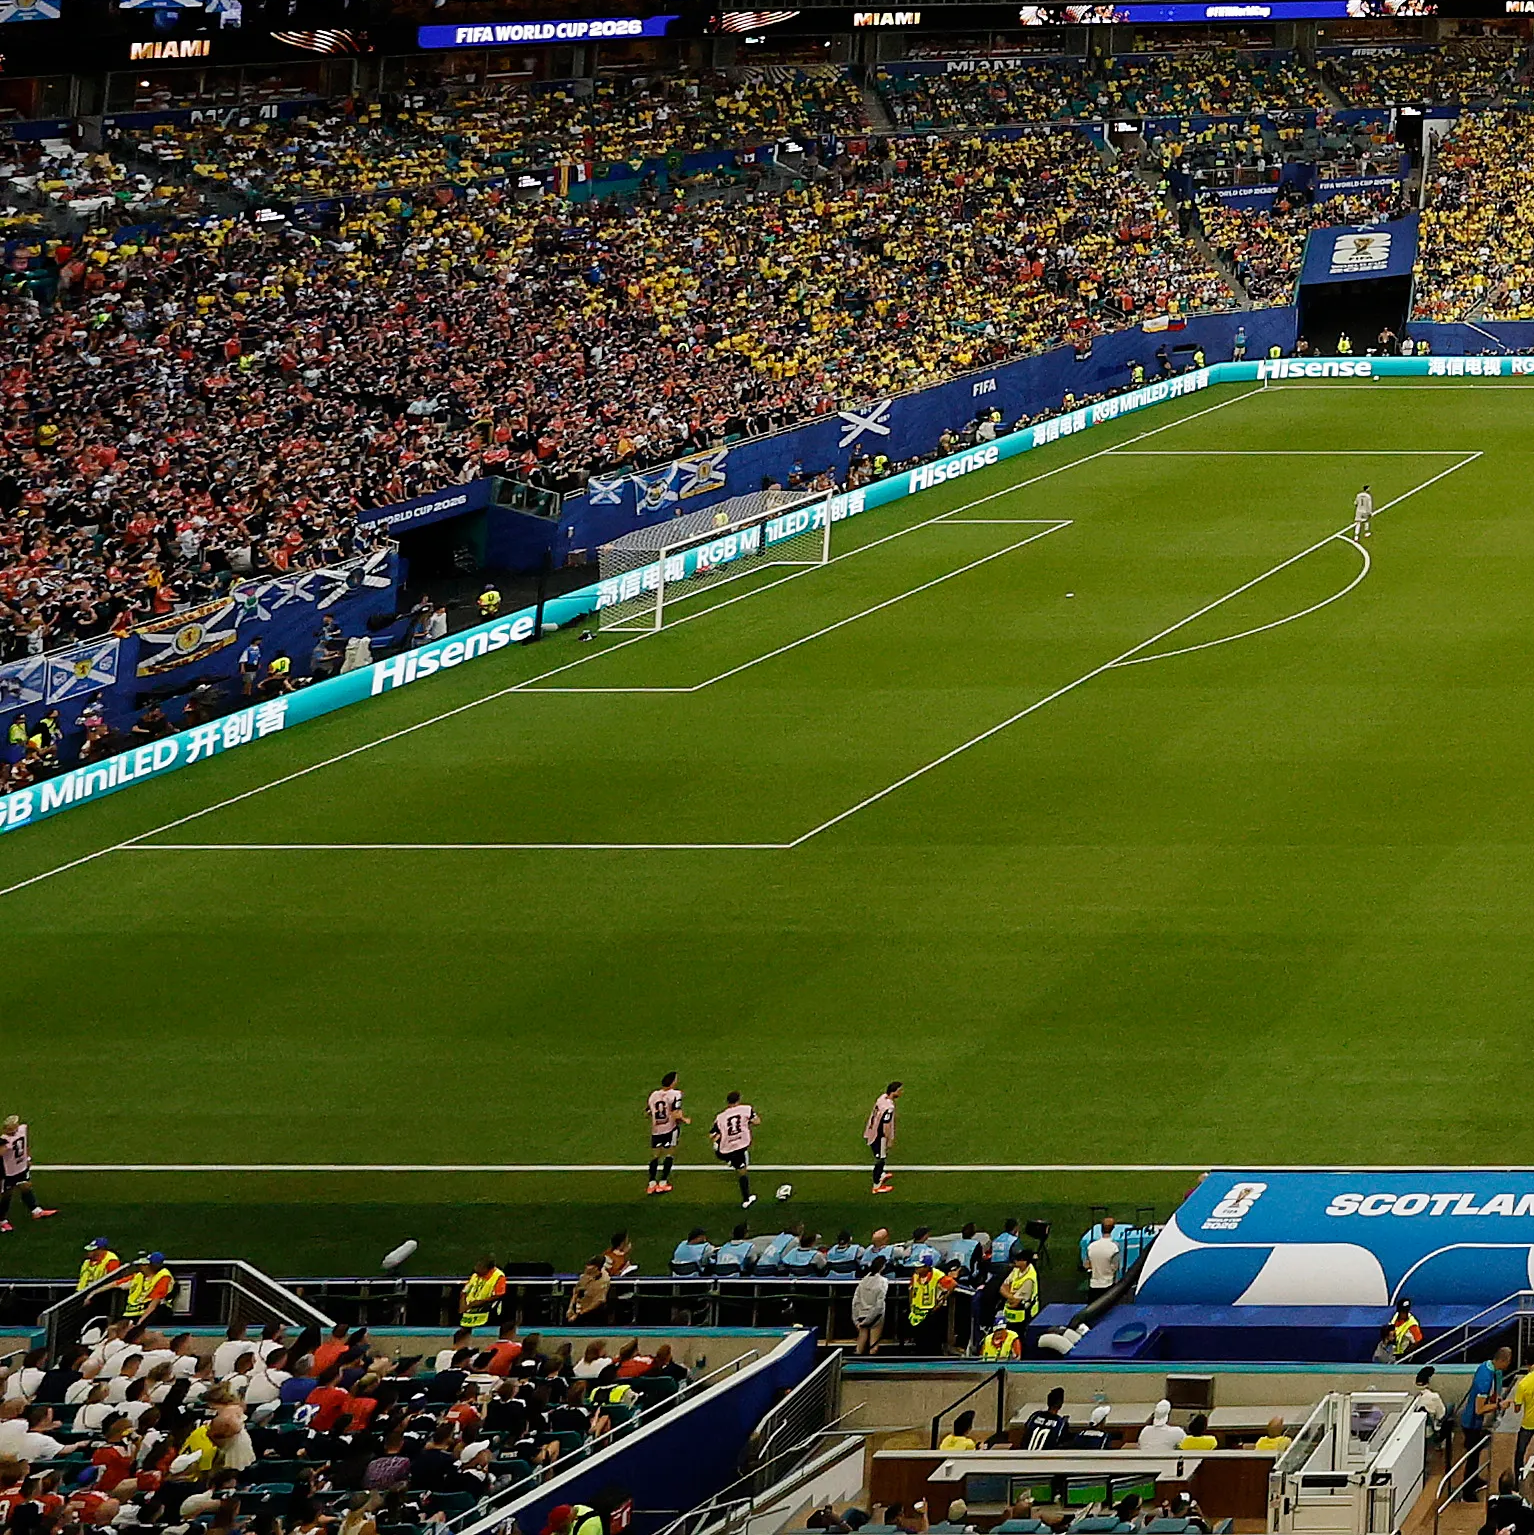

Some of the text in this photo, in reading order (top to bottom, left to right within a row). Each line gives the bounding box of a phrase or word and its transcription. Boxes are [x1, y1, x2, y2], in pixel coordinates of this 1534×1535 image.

[853, 12, 921, 26] MIAMI
[456, 19, 642, 44] FIFA WORLD CUP 2026
[130, 40, 210, 60] MIAMI
[1256, 358, 1372, 379] Hisense
[1427, 358, 1501, 376] 海信电视
[972, 377, 997, 397] FIFA
[908, 369, 1209, 494] Hisense 海信电视 RGB MiniLED 开创者
[378, 495, 467, 527] WORLD CUP 2026
[696, 535, 737, 568] RGB
[40, 613, 536, 814] MiniLED 开创者 Hisense
[1028, 1427, 1048, 1451] 10
